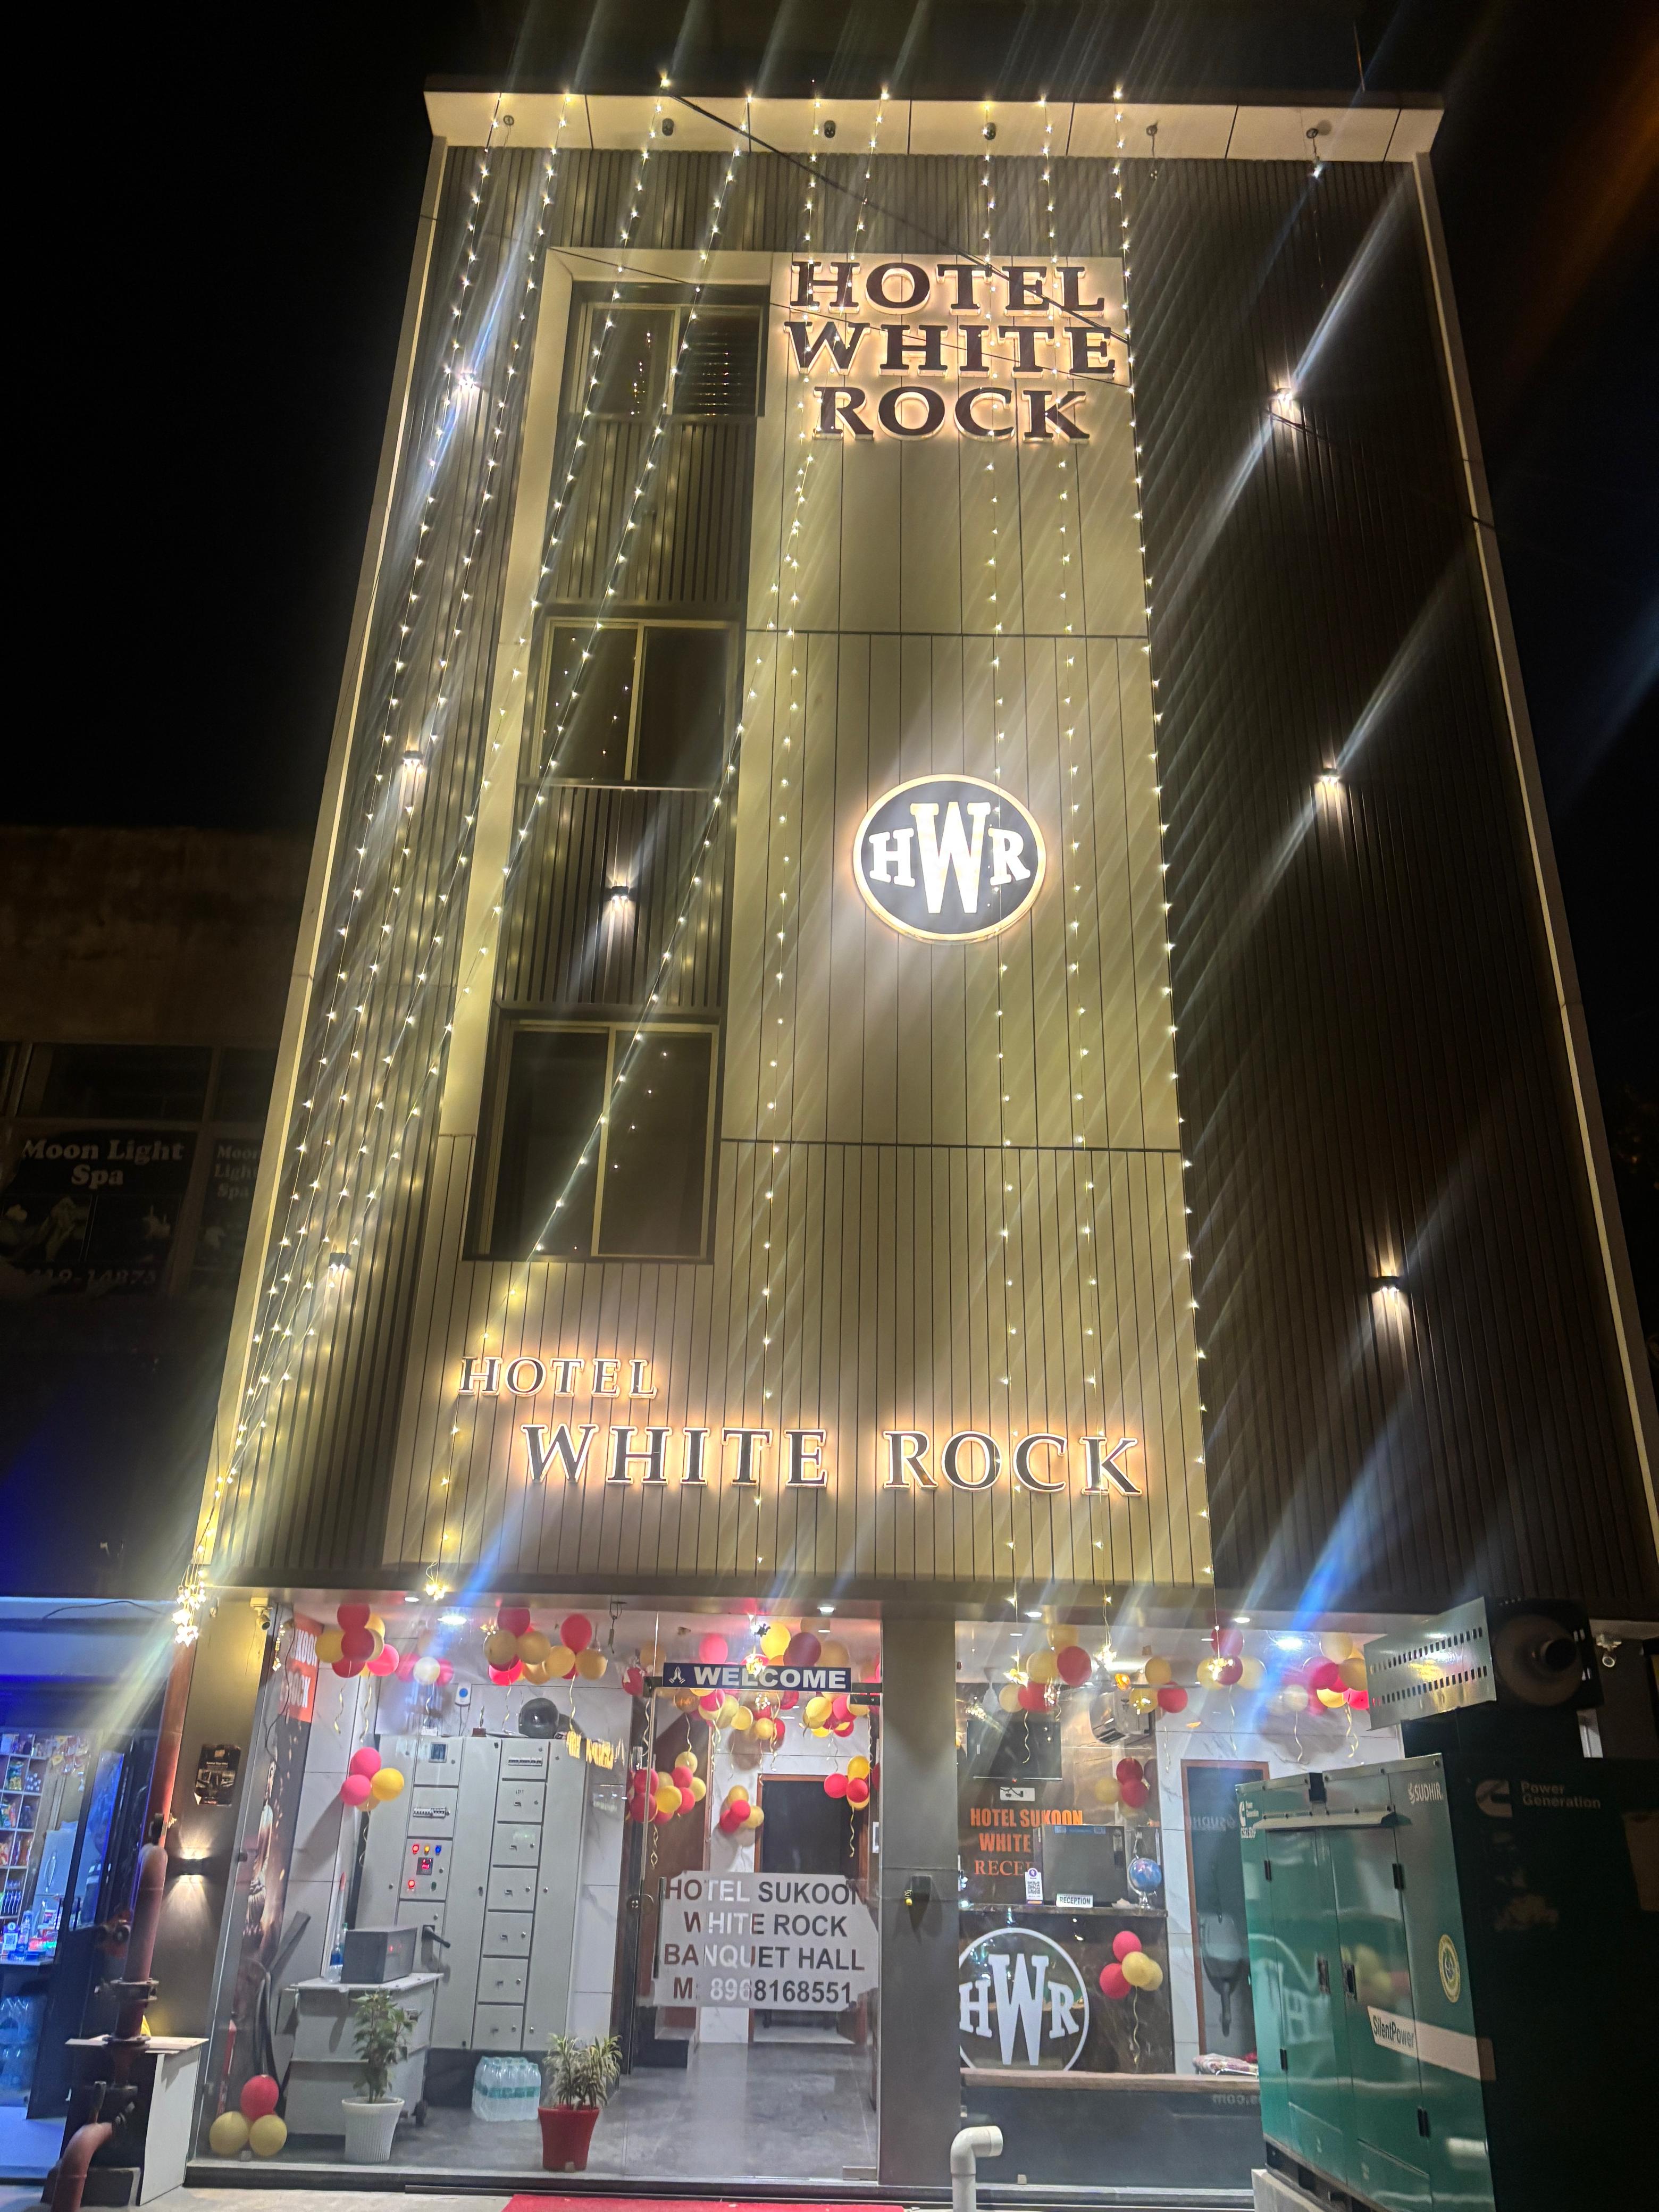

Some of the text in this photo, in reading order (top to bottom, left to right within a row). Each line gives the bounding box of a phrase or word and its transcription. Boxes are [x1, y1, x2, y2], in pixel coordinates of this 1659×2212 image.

[790, 261, 1105, 317] HOTEL
[783, 321, 1116, 380] WHITE
[812, 387, 1090, 443] ROCK
[869, 801, 1030, 914] HWR
[22, 1139, 185, 1166] Moon Light
[71, 1164, 124, 1189] Spa
[457, 1356, 658, 1400] HOTEL
[520, 1423, 1143, 1497] WHITE ROCK
[694, 1666, 847, 1689] WELCOME
[1521, 1781, 1565, 1795] Power
[1523, 1794, 1601, 1808] Generation
[970, 1808, 1083, 1828] HOTEL SUKOON
[978, 1833, 1032, 1853] WHITE
[665, 1879, 750, 1902] HOTEL
[1059, 1896, 1091, 1906] RECEPTION
[684, 1911, 848, 1937] WHITE ROCK
[664, 1943, 865, 1971] BANQUET HALL
[710, 1978, 851, 2004] 8968168551
[959, 1953, 1079, 2066] HWR
[1373, 2015, 1414, 2048] SilentPower
